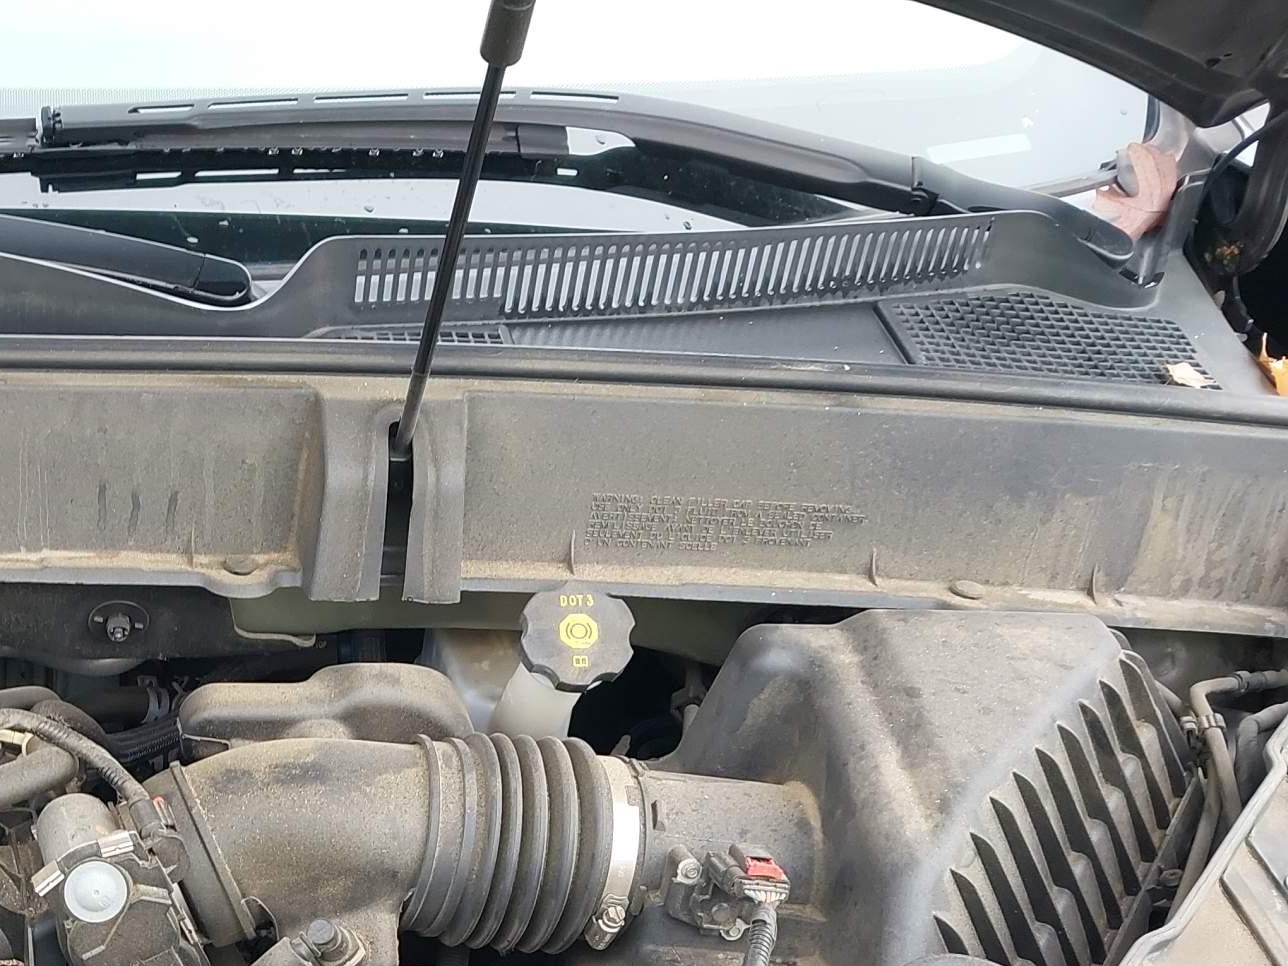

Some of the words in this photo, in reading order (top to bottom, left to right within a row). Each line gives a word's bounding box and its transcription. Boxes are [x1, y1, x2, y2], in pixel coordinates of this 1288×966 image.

[591, 501, 611, 511] USE
[616, 503, 644, 513] ONLY
[648, 504, 670, 515] DOT
[650, 495, 682, 506] CLEAN
[688, 496, 729, 508] FILLER
[559, 594, 584, 607] DOT
[586, 594, 594, 607] 3
